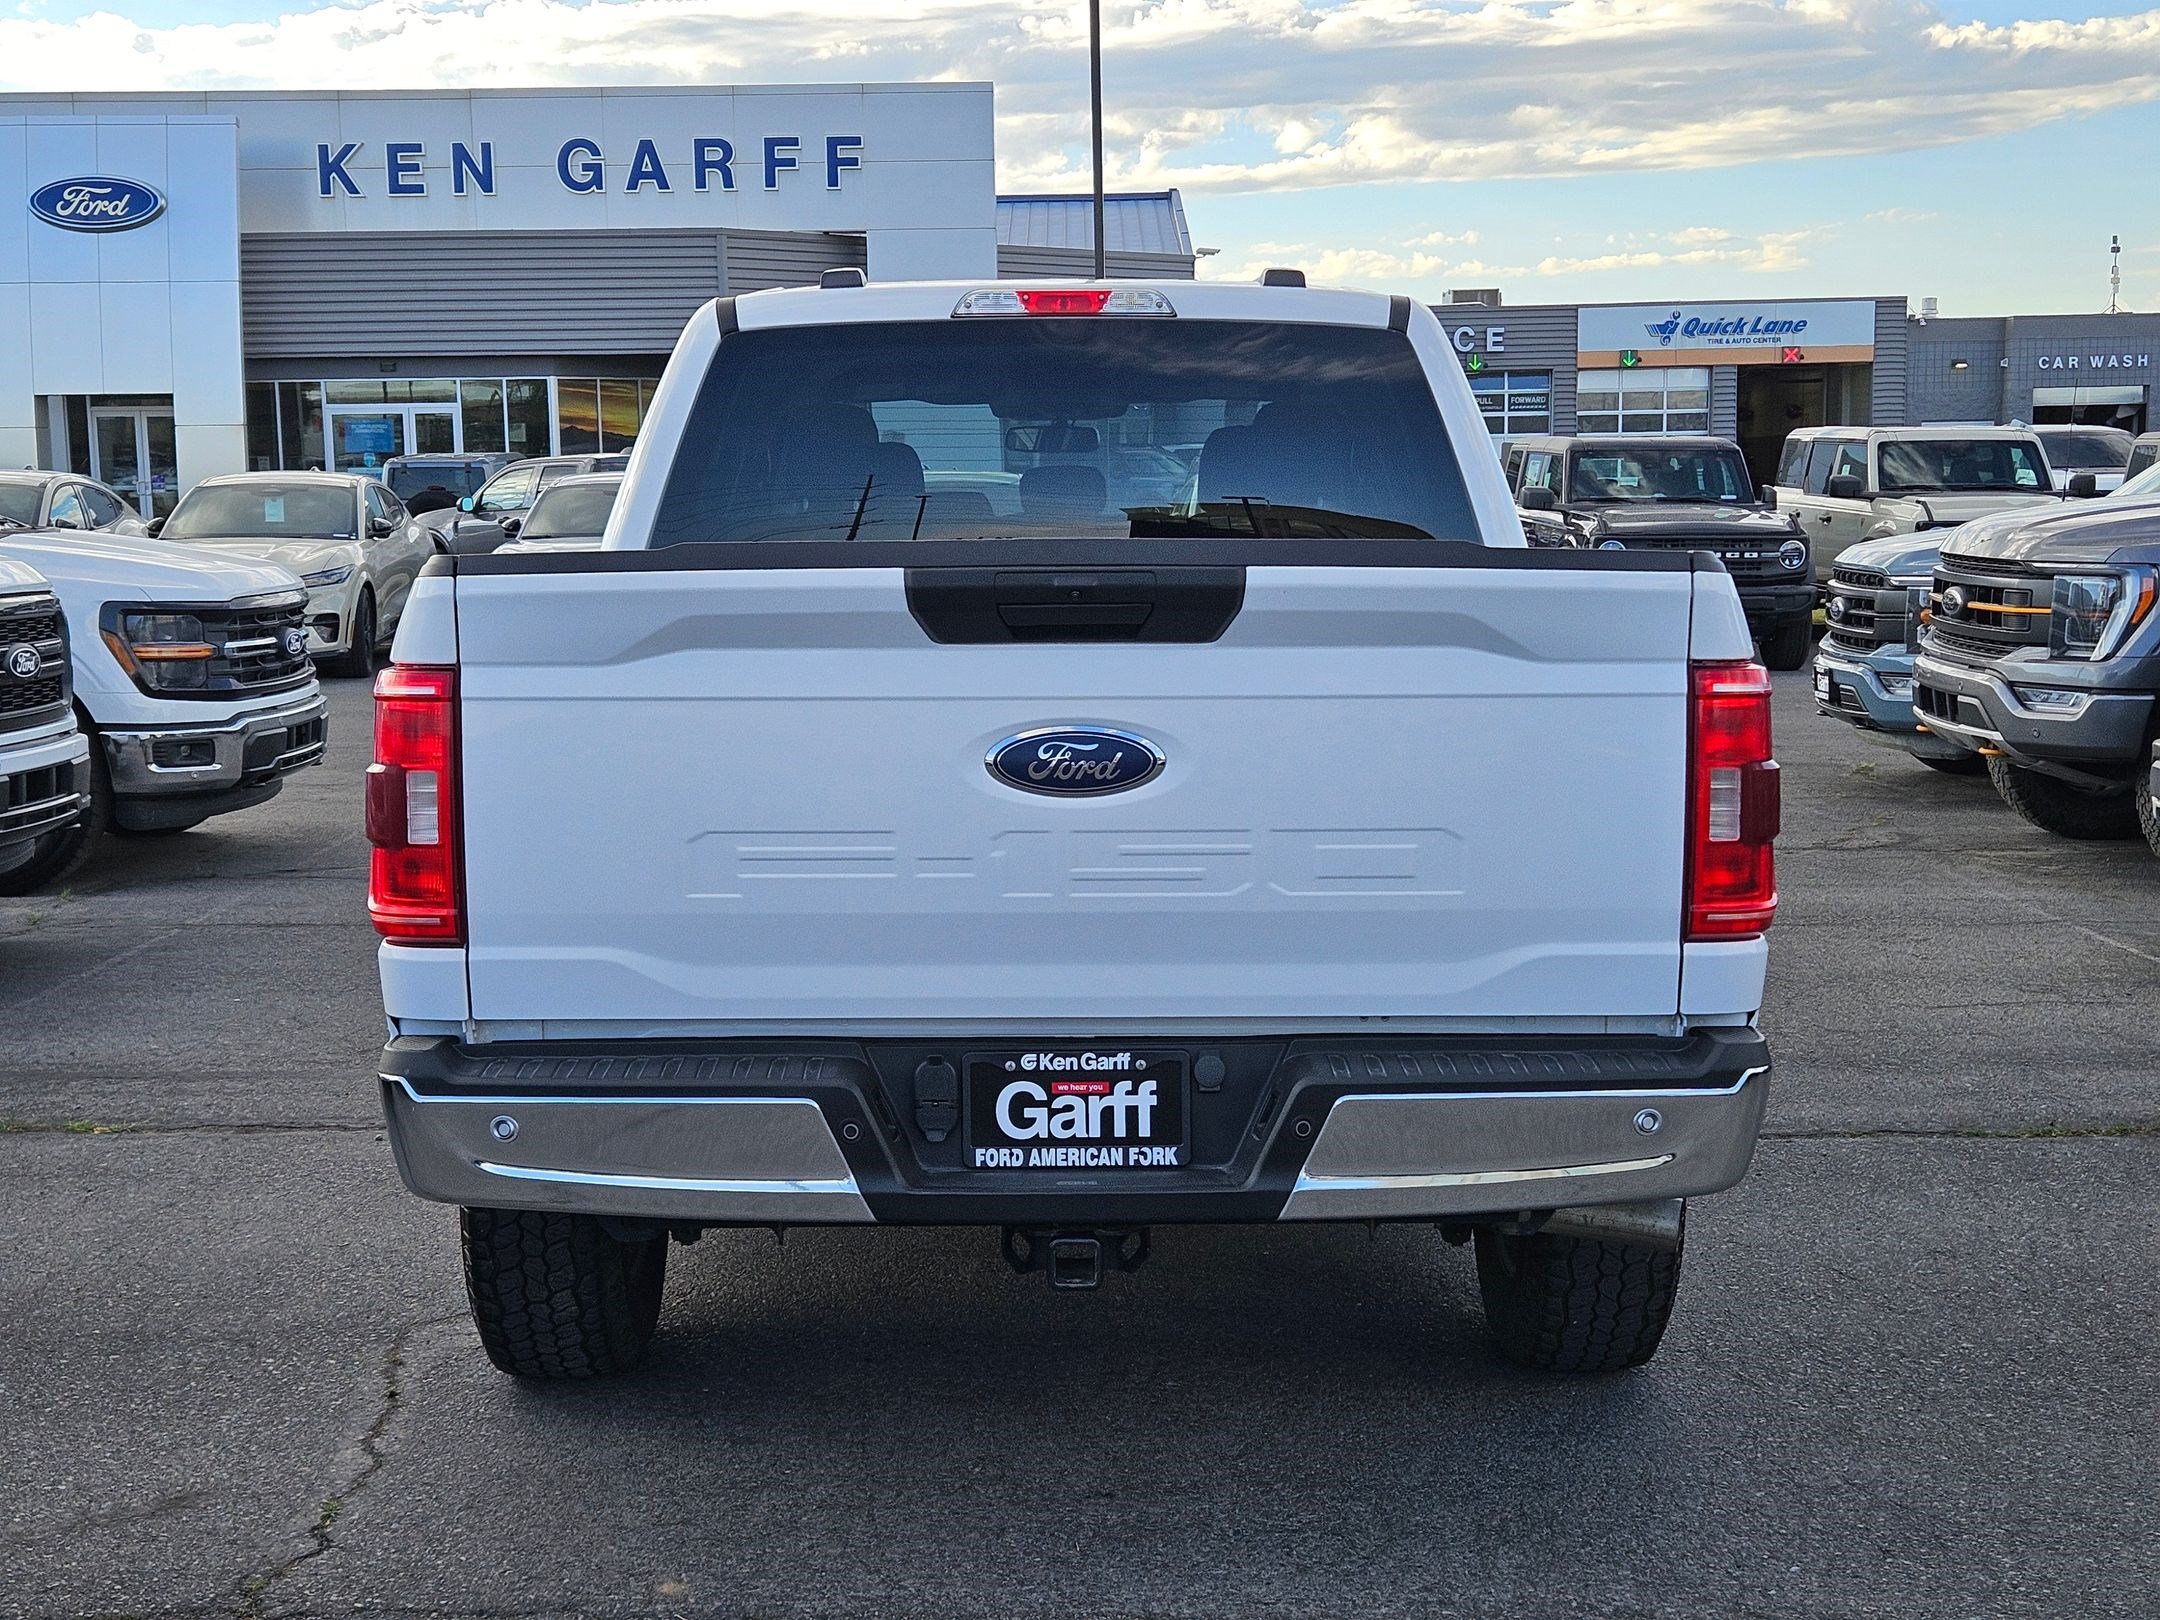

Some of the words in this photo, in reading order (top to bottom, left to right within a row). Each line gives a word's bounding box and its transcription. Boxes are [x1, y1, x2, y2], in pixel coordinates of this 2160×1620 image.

[316, 140, 499, 198] KEN
[556, 134, 865, 195] GARFF
[55, 185, 132, 217] Ford
[1682, 316, 1749, 339] Quick
[1750, 316, 1808, 336] Lane
[1753, 336, 1782, 344] CENTER
[2038, 356, 2079, 369] CAR
[2089, 354, 2149, 369] WASH
[1475, 397, 1493, 405] PULL
[1510, 396, 1547, 404] FORWARD
[16, 652, 38, 673] Ford
[1027, 741, 1123, 781] Ford
[685, 827, 1466, 899] F-150
[1039, 1053, 1078, 1071] Ken
[1080, 1052, 1131, 1070] Garff
[1070, 1083, 1088, 1091] hear
[1089, 1084, 1103, 1093] you
[995, 1080, 1157, 1140] Garff
[975, 1148, 1024, 1167] FORD
[1029, 1148, 1123, 1167] AMERICAN
[1129, 1147, 1179, 1166] FORK
